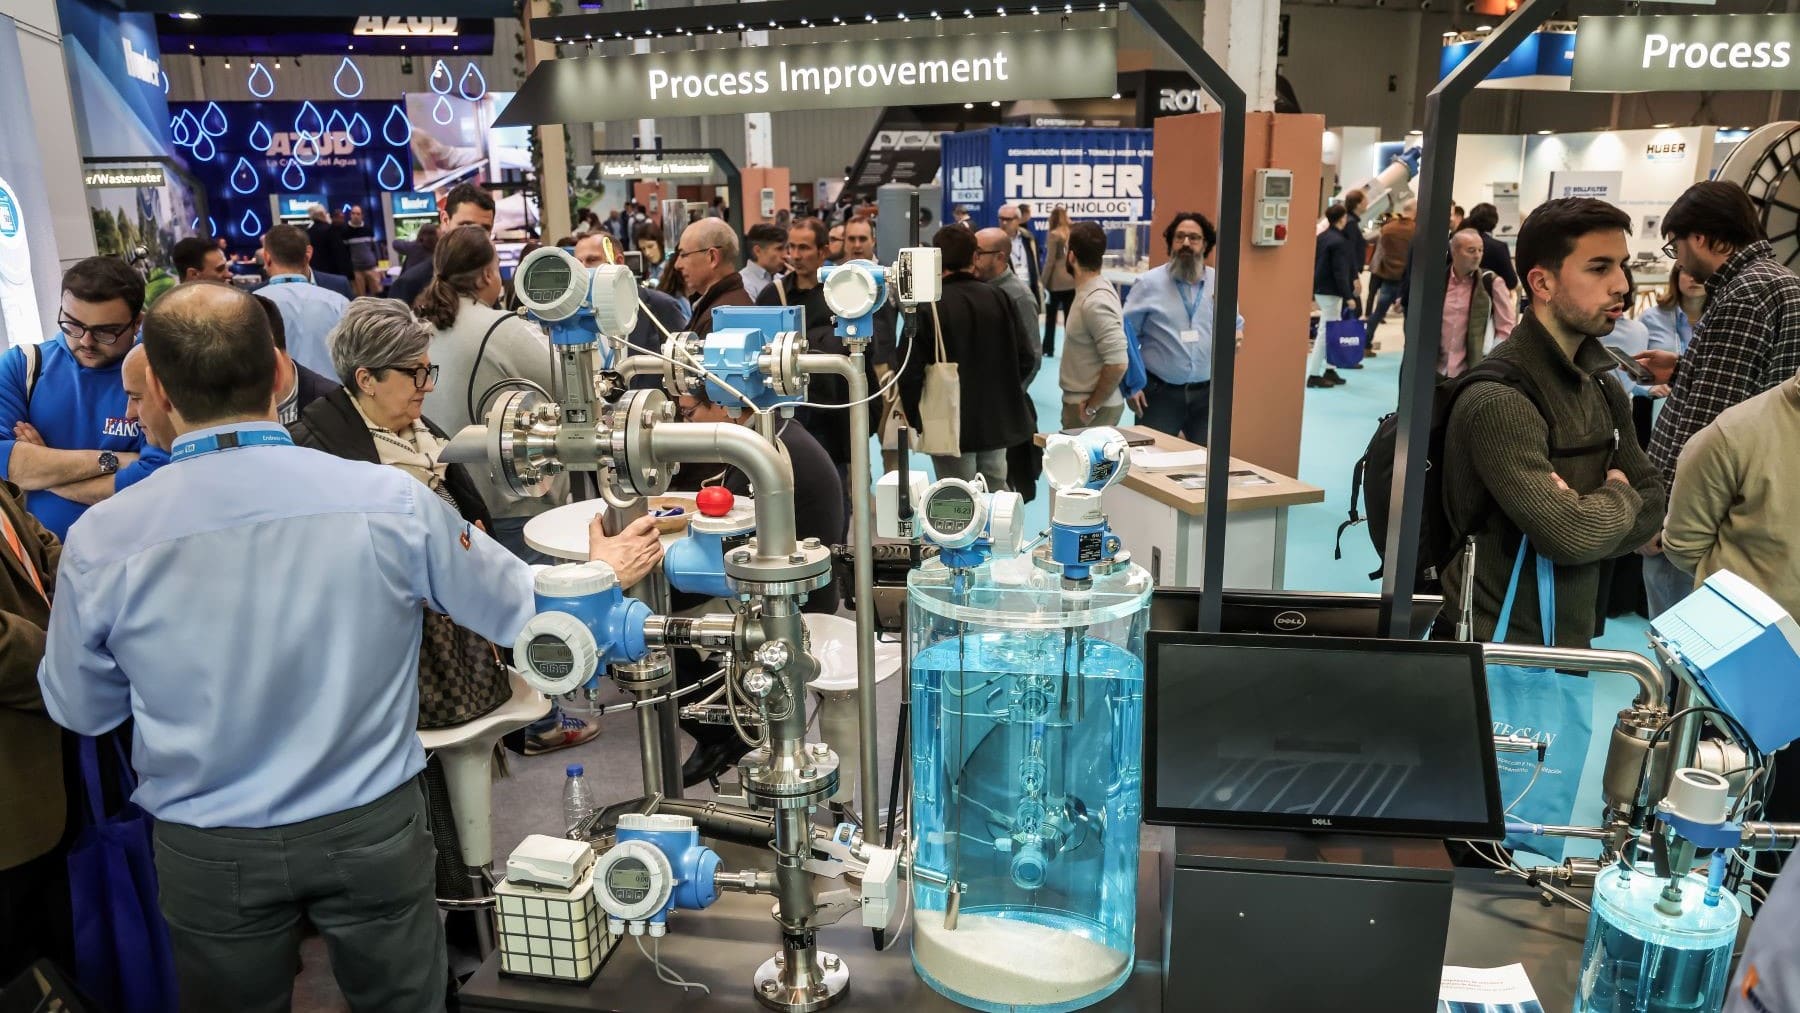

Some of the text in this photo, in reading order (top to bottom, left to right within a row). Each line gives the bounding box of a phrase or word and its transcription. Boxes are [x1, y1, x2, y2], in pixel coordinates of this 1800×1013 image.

[1642, 33, 1791, 69] Process
[649, 51, 1009, 99] Process Improvement
[1160, 88, 1201, 112] ROT
[265, 132, 355, 156] AZUD
[1645, 143, 1686, 154] HUBER
[1004, 163, 1144, 198] HUBER
[1035, 202, 1133, 213] TEHNOLOG
[102, 418, 139, 437] JEANS
[1311, 818, 1333, 826] DELL
